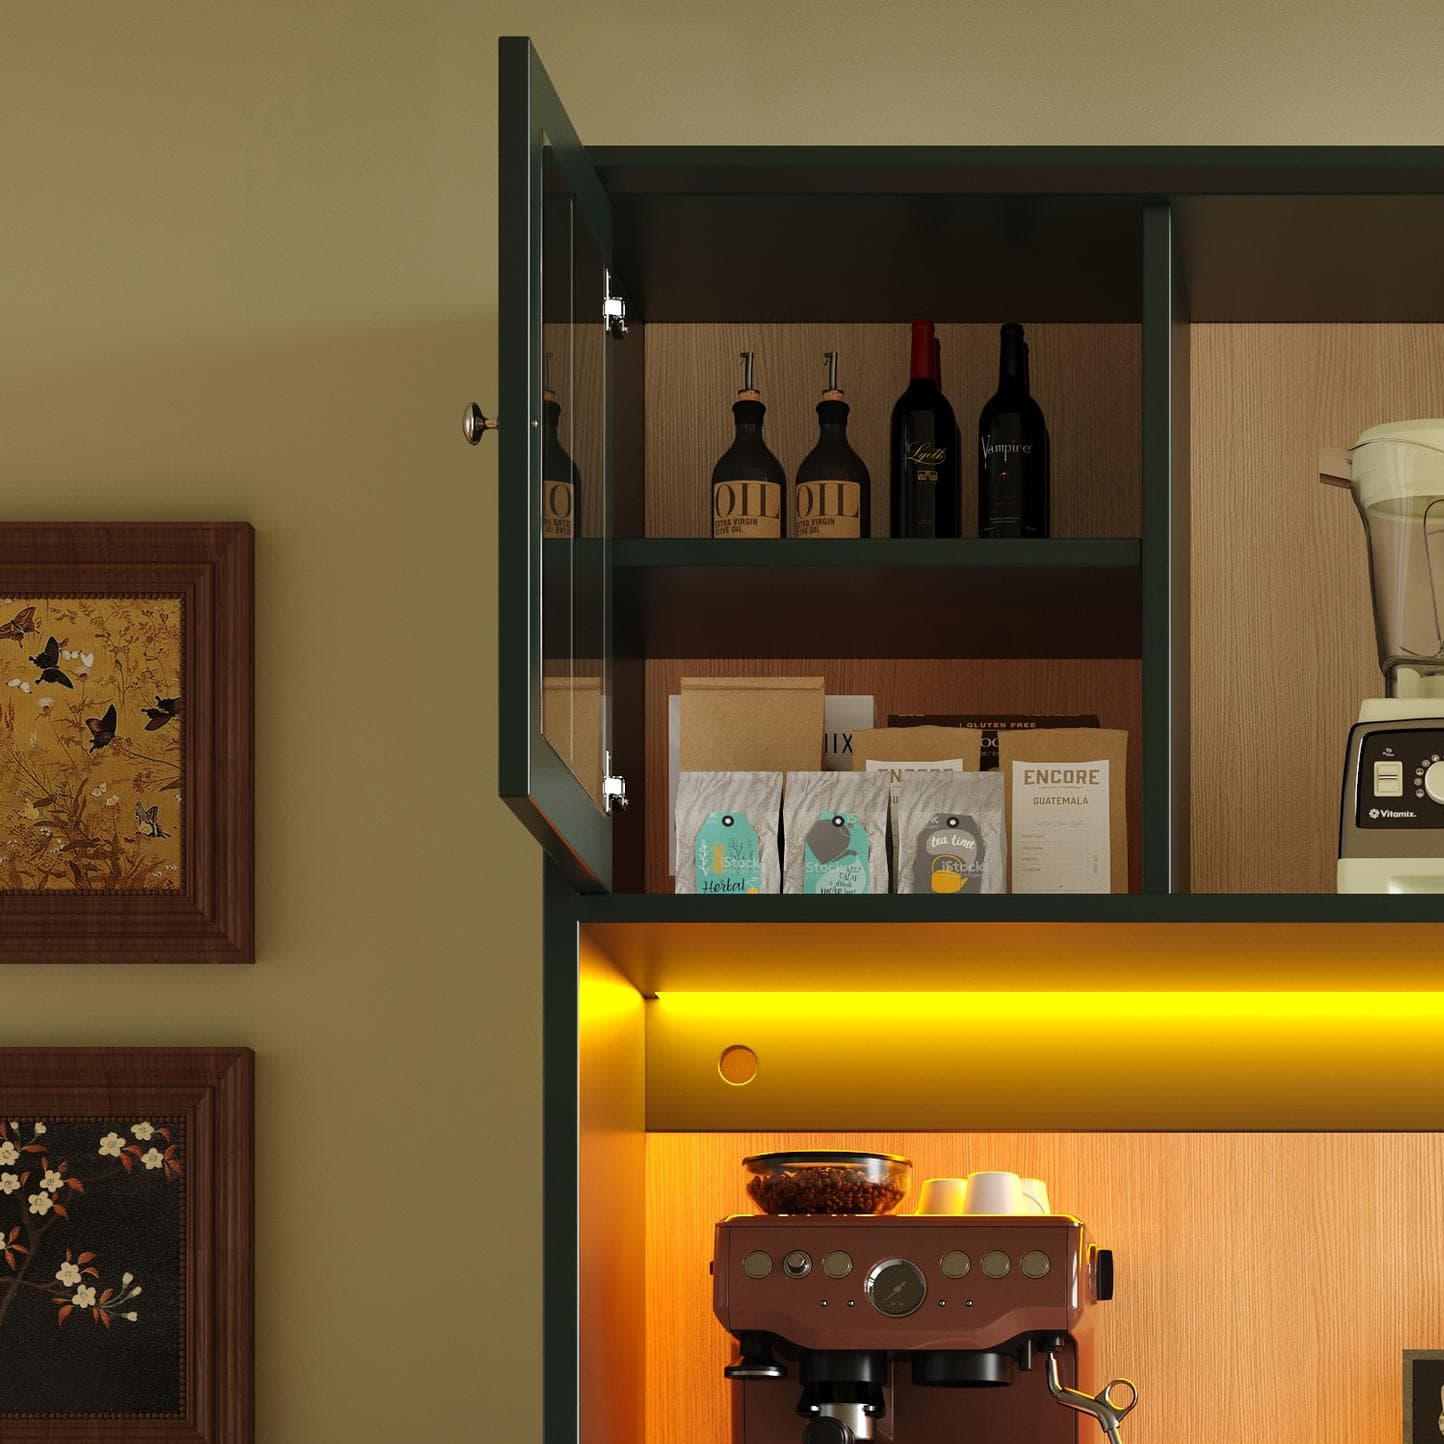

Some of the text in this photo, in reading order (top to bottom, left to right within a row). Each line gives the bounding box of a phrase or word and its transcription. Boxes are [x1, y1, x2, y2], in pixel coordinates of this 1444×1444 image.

[981, 434, 1033, 470] Vampire
[715, 484, 780, 519] OIL
[797, 484, 859, 519] OIL
[1024, 769, 1100, 785] ENCORE
[1033, 796, 1089, 806] GUATEMALA
[1380, 809, 1417, 819] Vitamix
[931, 834, 976, 850] tea time
[703, 878, 745, 893] Herbal
